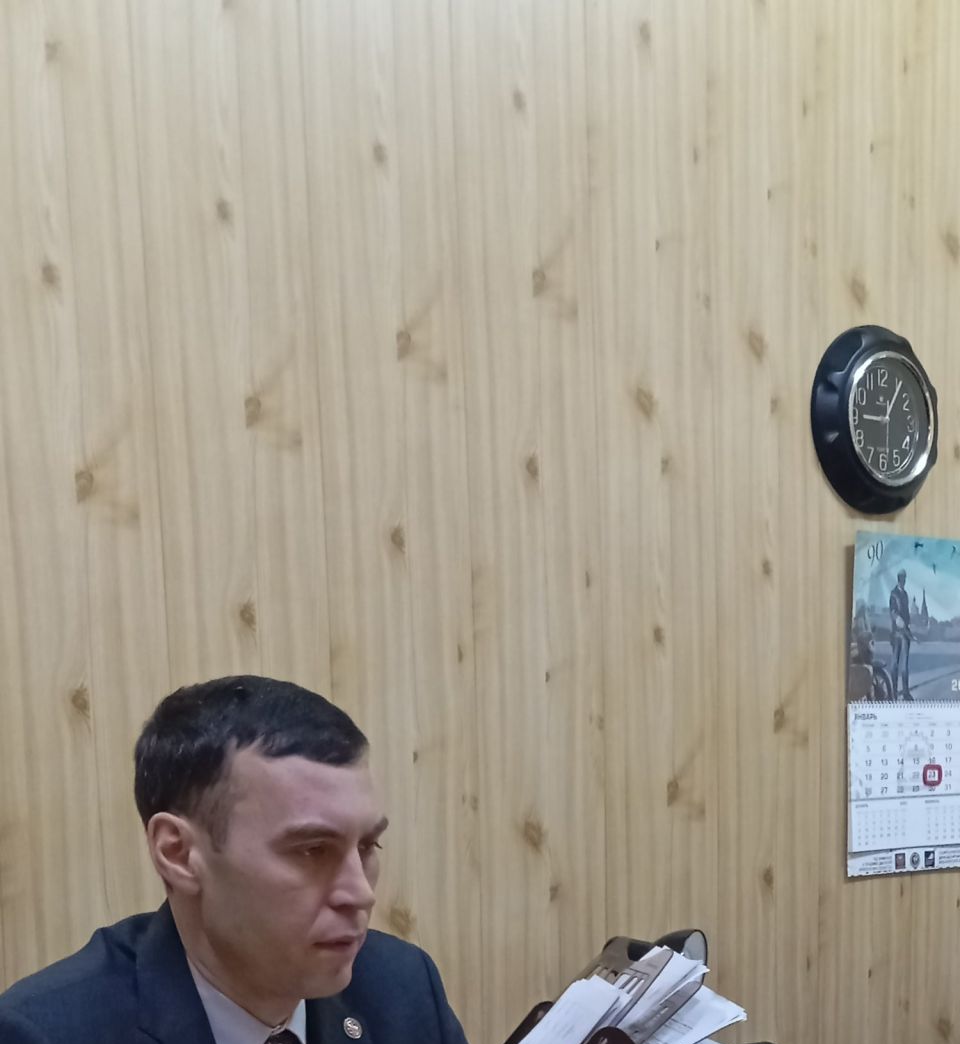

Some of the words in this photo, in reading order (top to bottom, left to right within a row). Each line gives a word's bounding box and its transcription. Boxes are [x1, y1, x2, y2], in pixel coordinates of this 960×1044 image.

[866, 372, 874, 391] 11
[877, 369, 888, 387] 12
[854, 387, 867, 406] 10
[902, 392, 910, 411] 2
[906, 415, 915, 433] 3
[855, 429, 865, 448] 8
[901, 435, 910, 450] 4
[866, 447, 875, 464] 7
[878, 452, 888, 472] 6
[892, 449, 901, 467] 5
